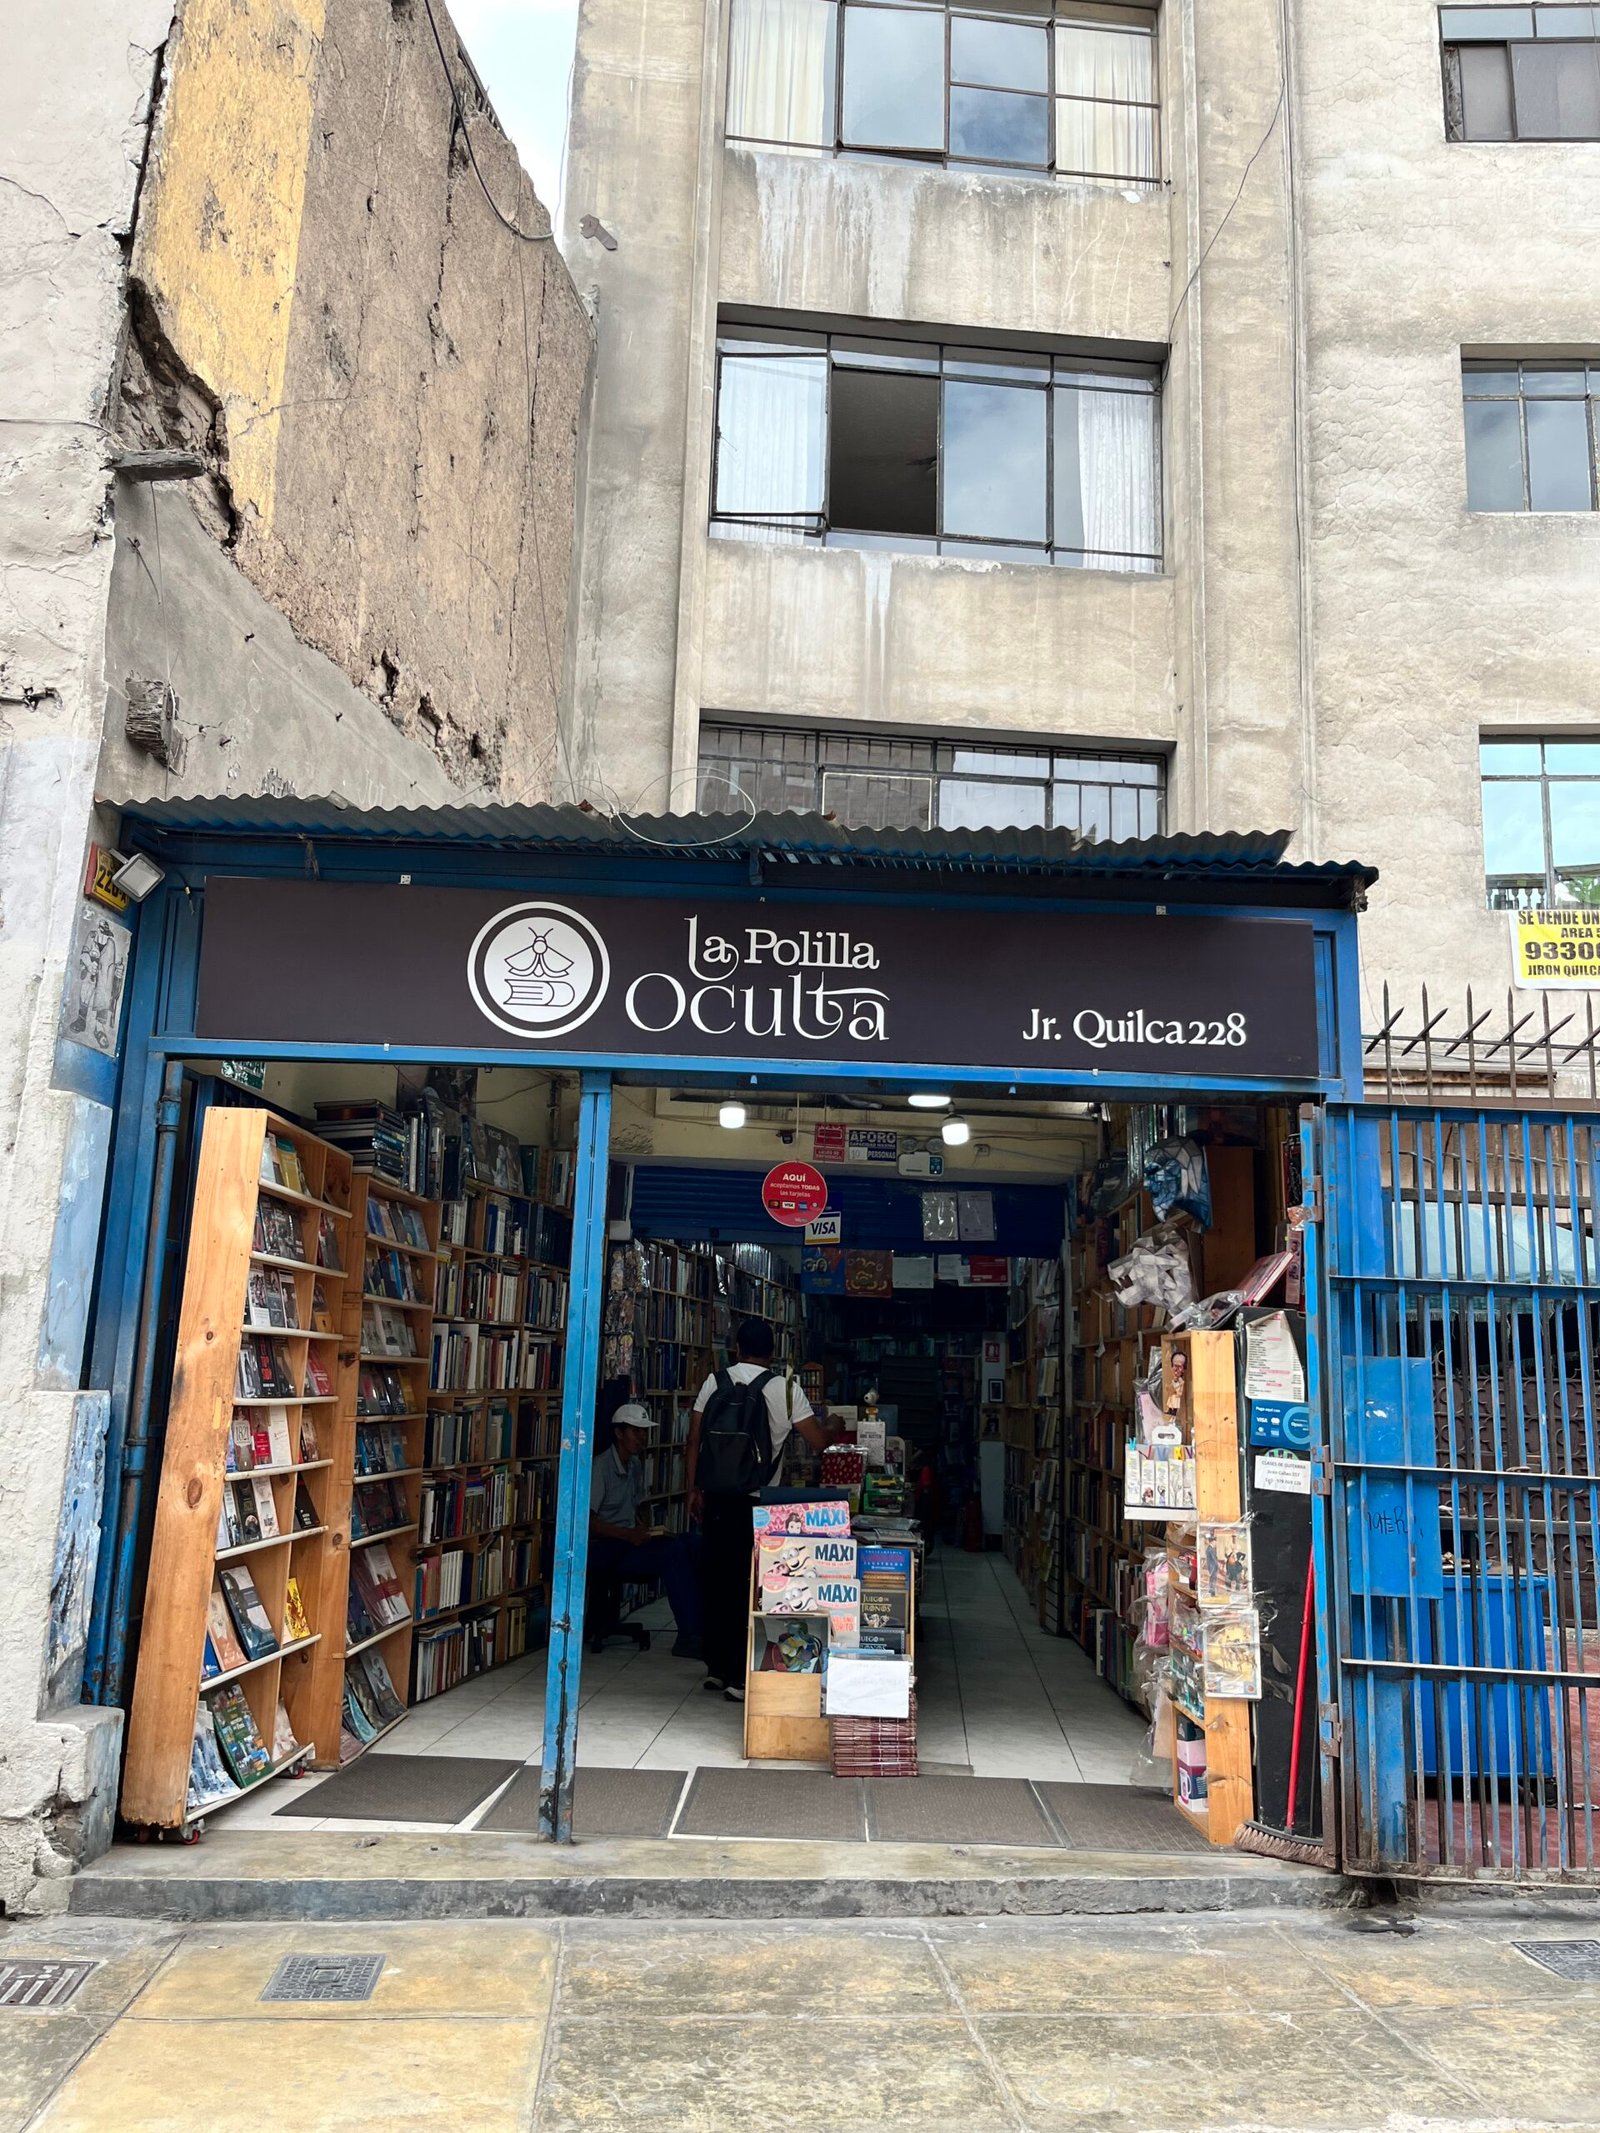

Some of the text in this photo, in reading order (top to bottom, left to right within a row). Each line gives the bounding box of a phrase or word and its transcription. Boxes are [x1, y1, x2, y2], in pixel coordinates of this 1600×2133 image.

[1518, 911, 1534, 925] SE
[1537, 911, 1579, 925] VENDE
[1561, 928, 1593, 938] AREA
[743, 928, 880, 970] Polilla
[1525, 942, 1600, 960] 9330
[1528, 965, 1560, 976] JIRON
[625, 971, 890, 1041] Oculta
[1022, 1008, 1062, 1041] Jr.
[850, 1131, 896, 1144] AFORO
[868, 1150, 896, 1160] PERSONAS
[783, 1173, 806, 1182] AQUÍ
[810, 1221, 836, 1235] VISA
[806, 1508, 846, 1526] MAXI
[815, 1543, 854, 1561] MAXI
[818, 1584, 857, 1603] MAXI
[863, 1593, 884, 1603] JUEGO
[861, 1603, 891, 1613] TRONOS
